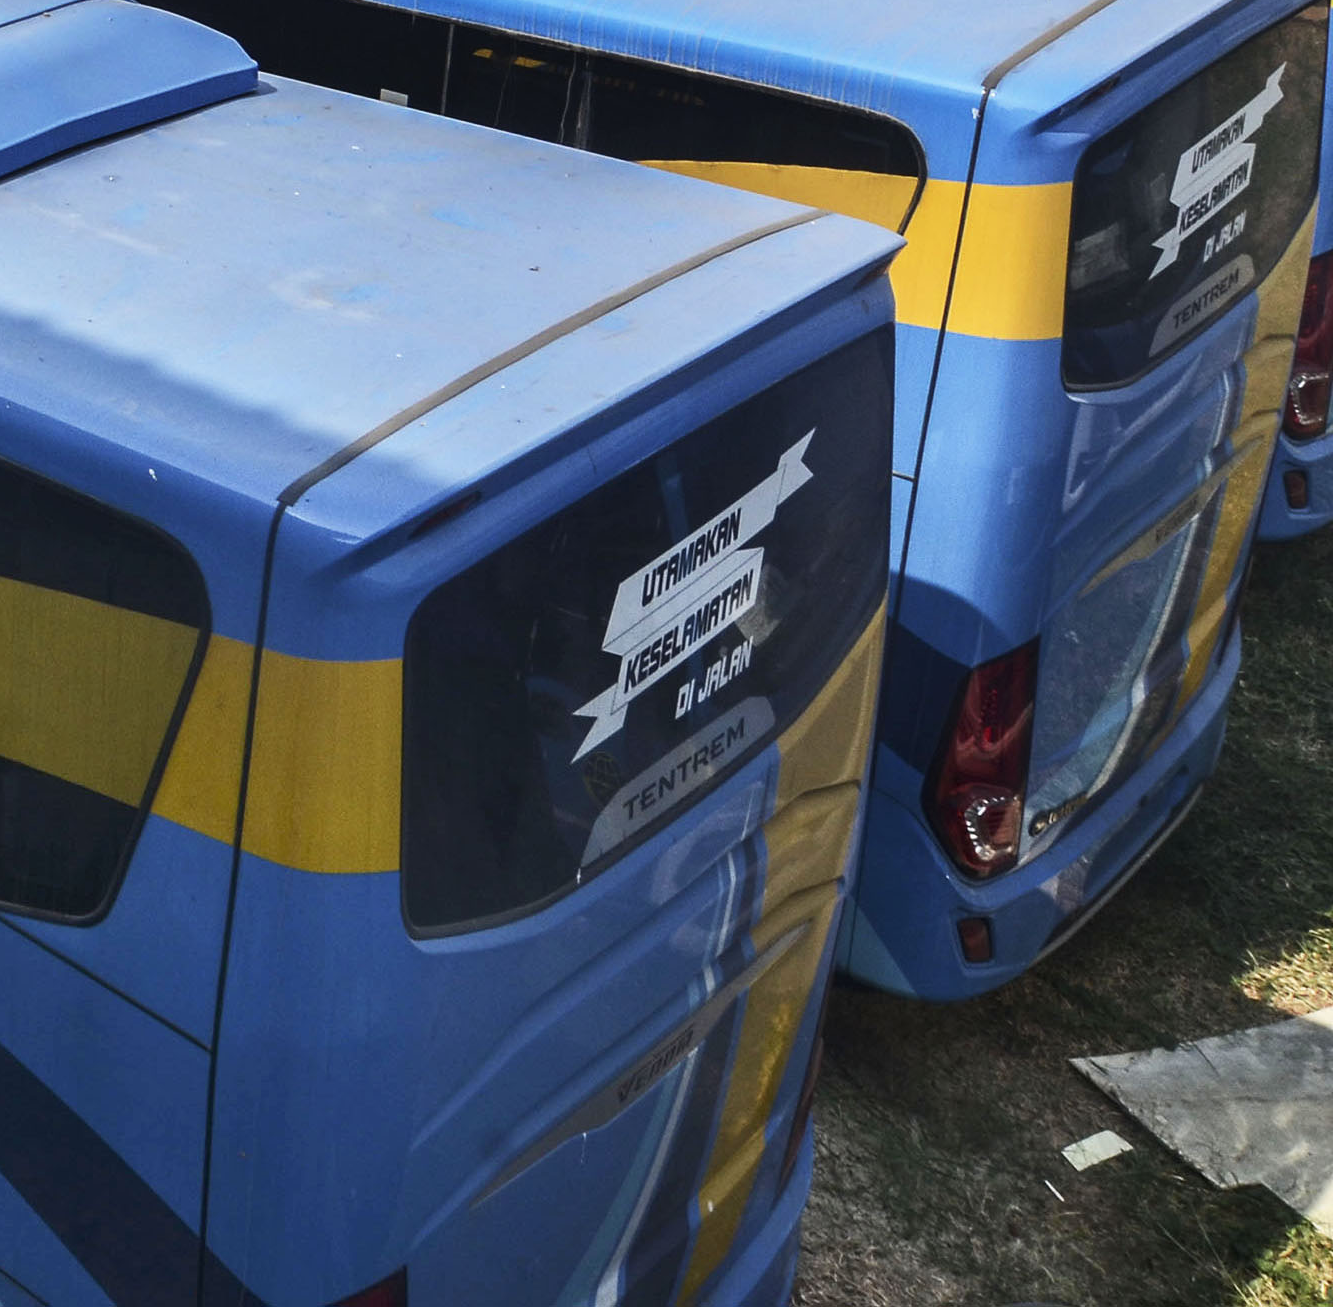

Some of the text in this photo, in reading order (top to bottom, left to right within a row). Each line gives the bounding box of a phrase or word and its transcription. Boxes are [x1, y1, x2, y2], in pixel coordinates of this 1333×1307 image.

[1191, 112, 1246, 174] UTAMAKAN
[1179, 158, 1250, 235] KESELAMATAN
[1203, 209, 1247, 263] DI JALAN
[1173, 267, 1240, 329] TENTREM
[641, 507, 742, 608] UTAMAKAN
[623, 568, 754, 695] KESELAMATAN
[675, 635, 754, 720] DI JALAN
[622, 716, 746, 822] TENTREM
